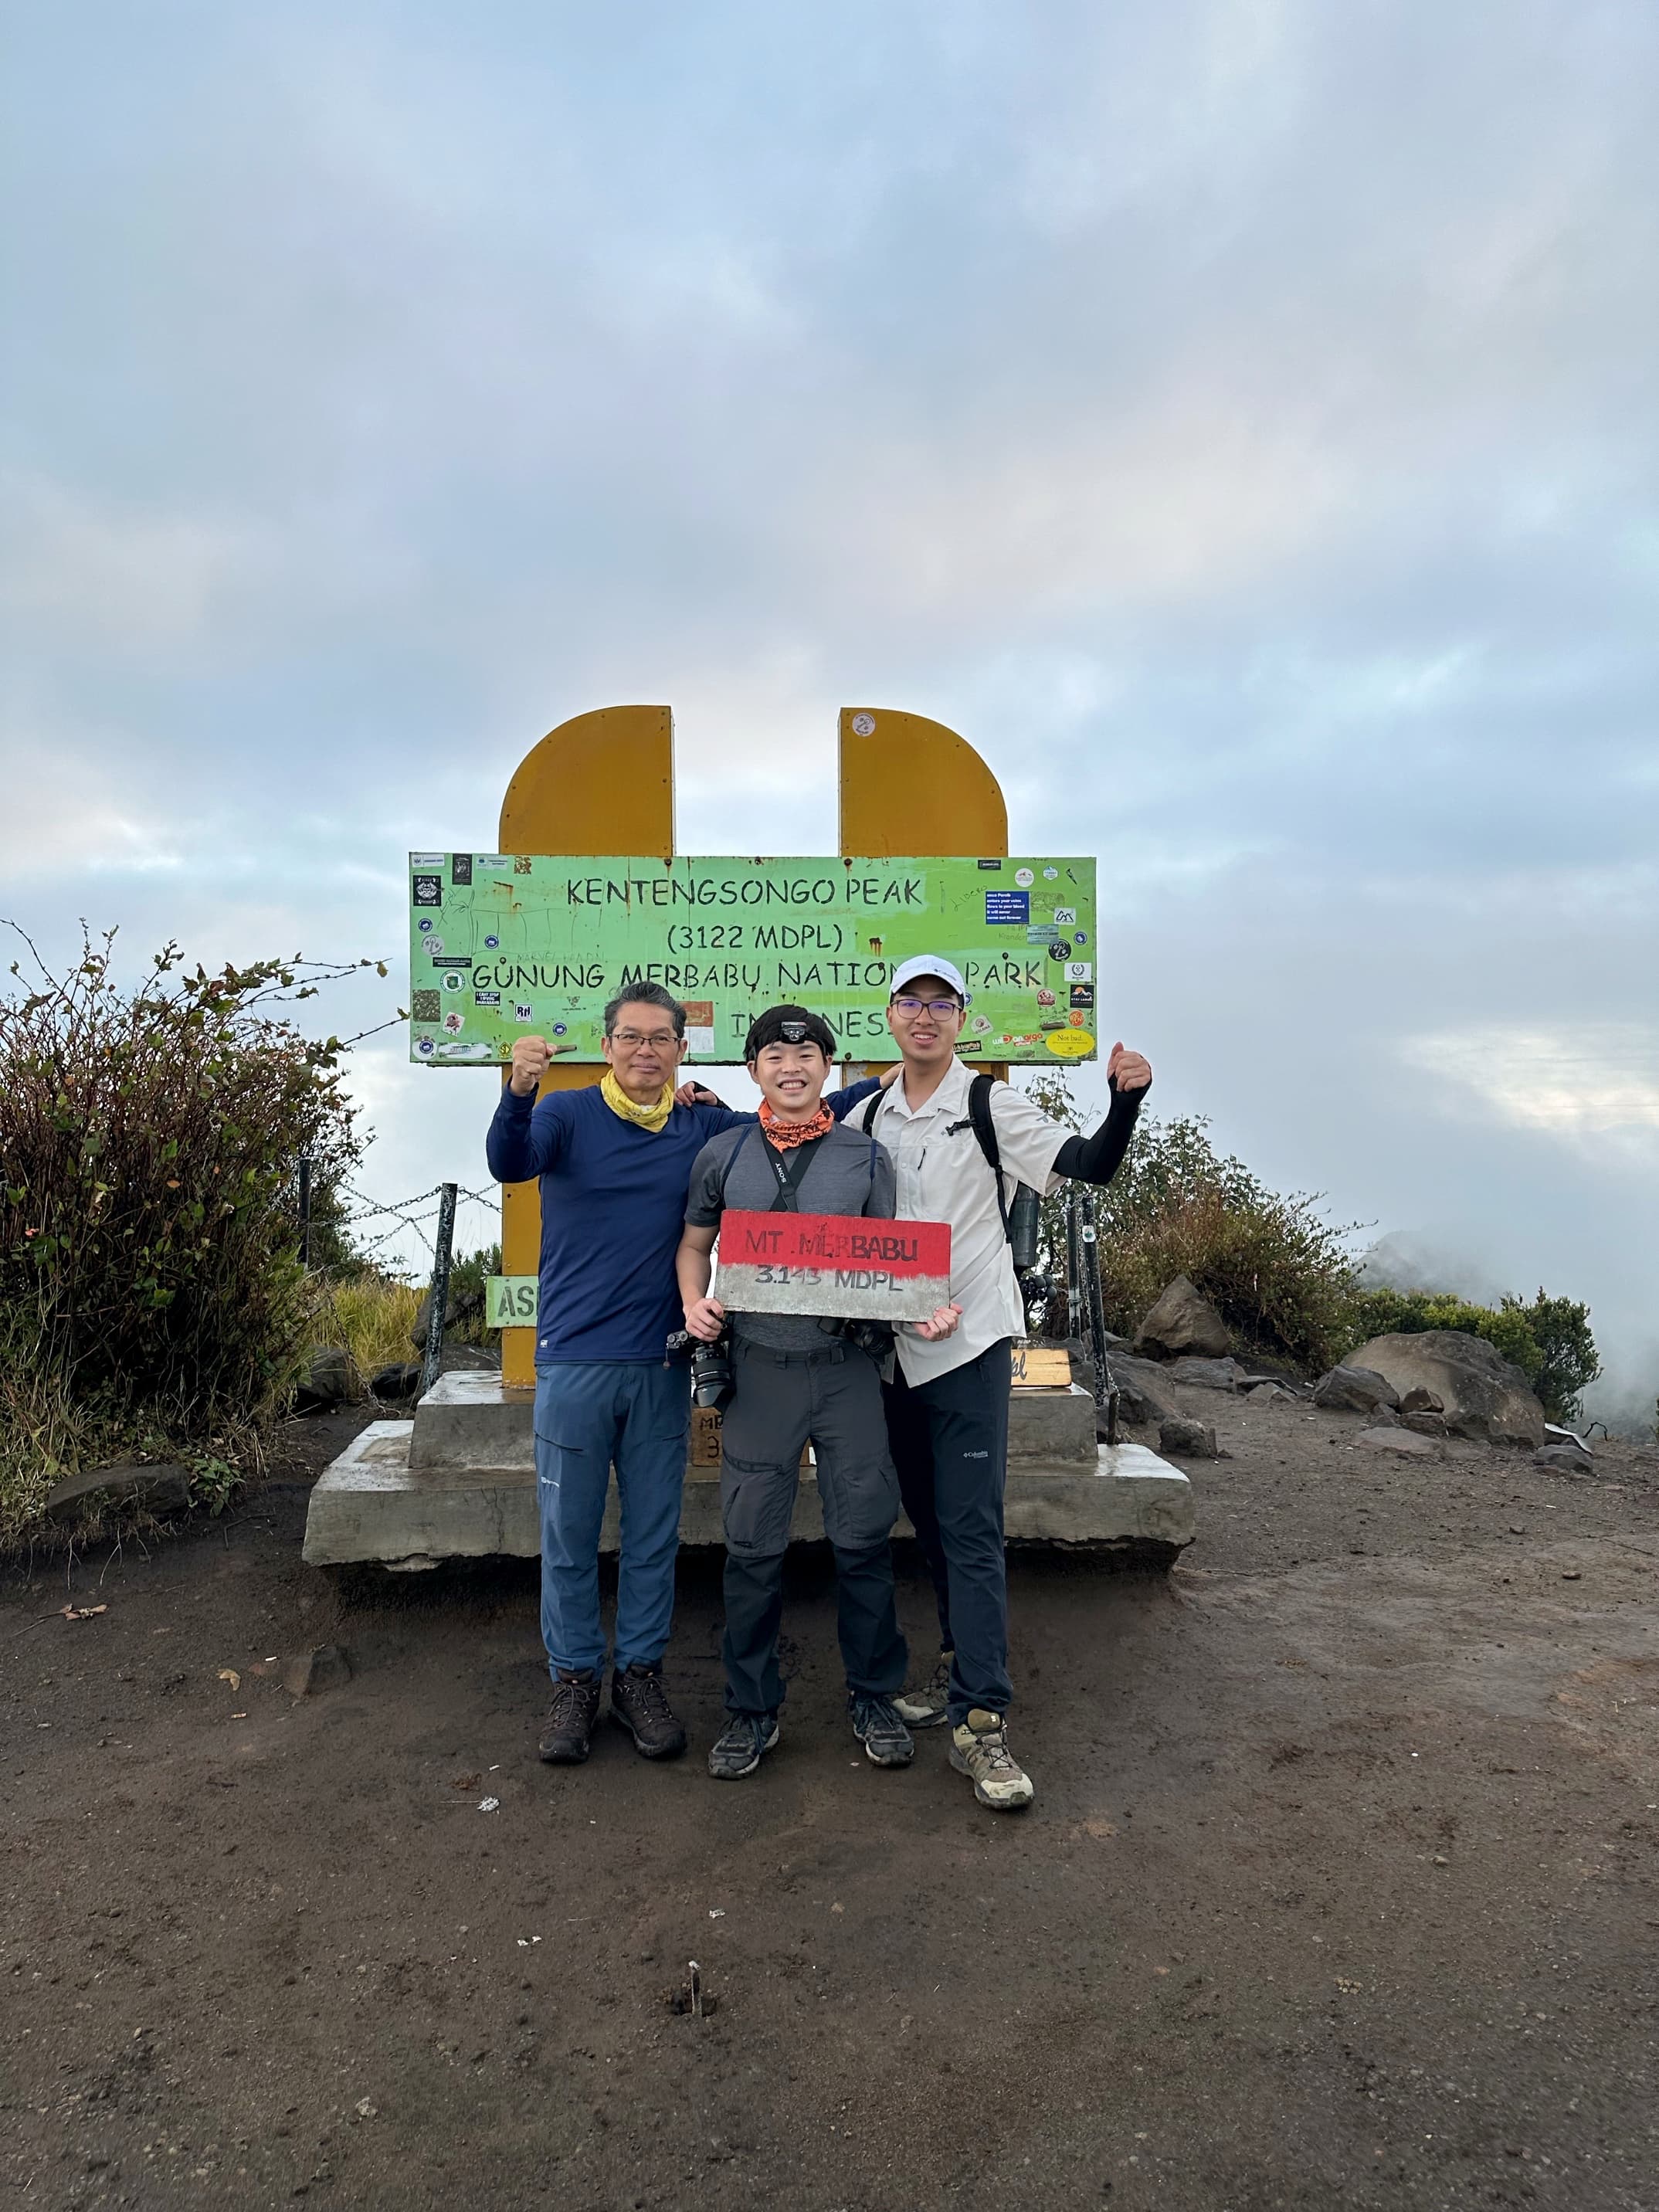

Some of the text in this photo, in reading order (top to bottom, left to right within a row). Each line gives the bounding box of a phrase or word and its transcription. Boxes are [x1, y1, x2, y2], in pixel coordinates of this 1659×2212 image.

[568, 878, 922, 905] KENTENGSONGO PEAK
[667, 924, 843, 954] (3122 MDPL)
[473, 963, 605, 989] GUNUNG
[779, 962, 897, 987] NATIO
[965, 961, 1042, 987] PARK
[775, 1162, 787, 1183] SONY
[799, 1233, 918, 1262] MERBABU
[835, 1268, 904, 1291] MDPL
[497, 1285, 539, 1317] AS
